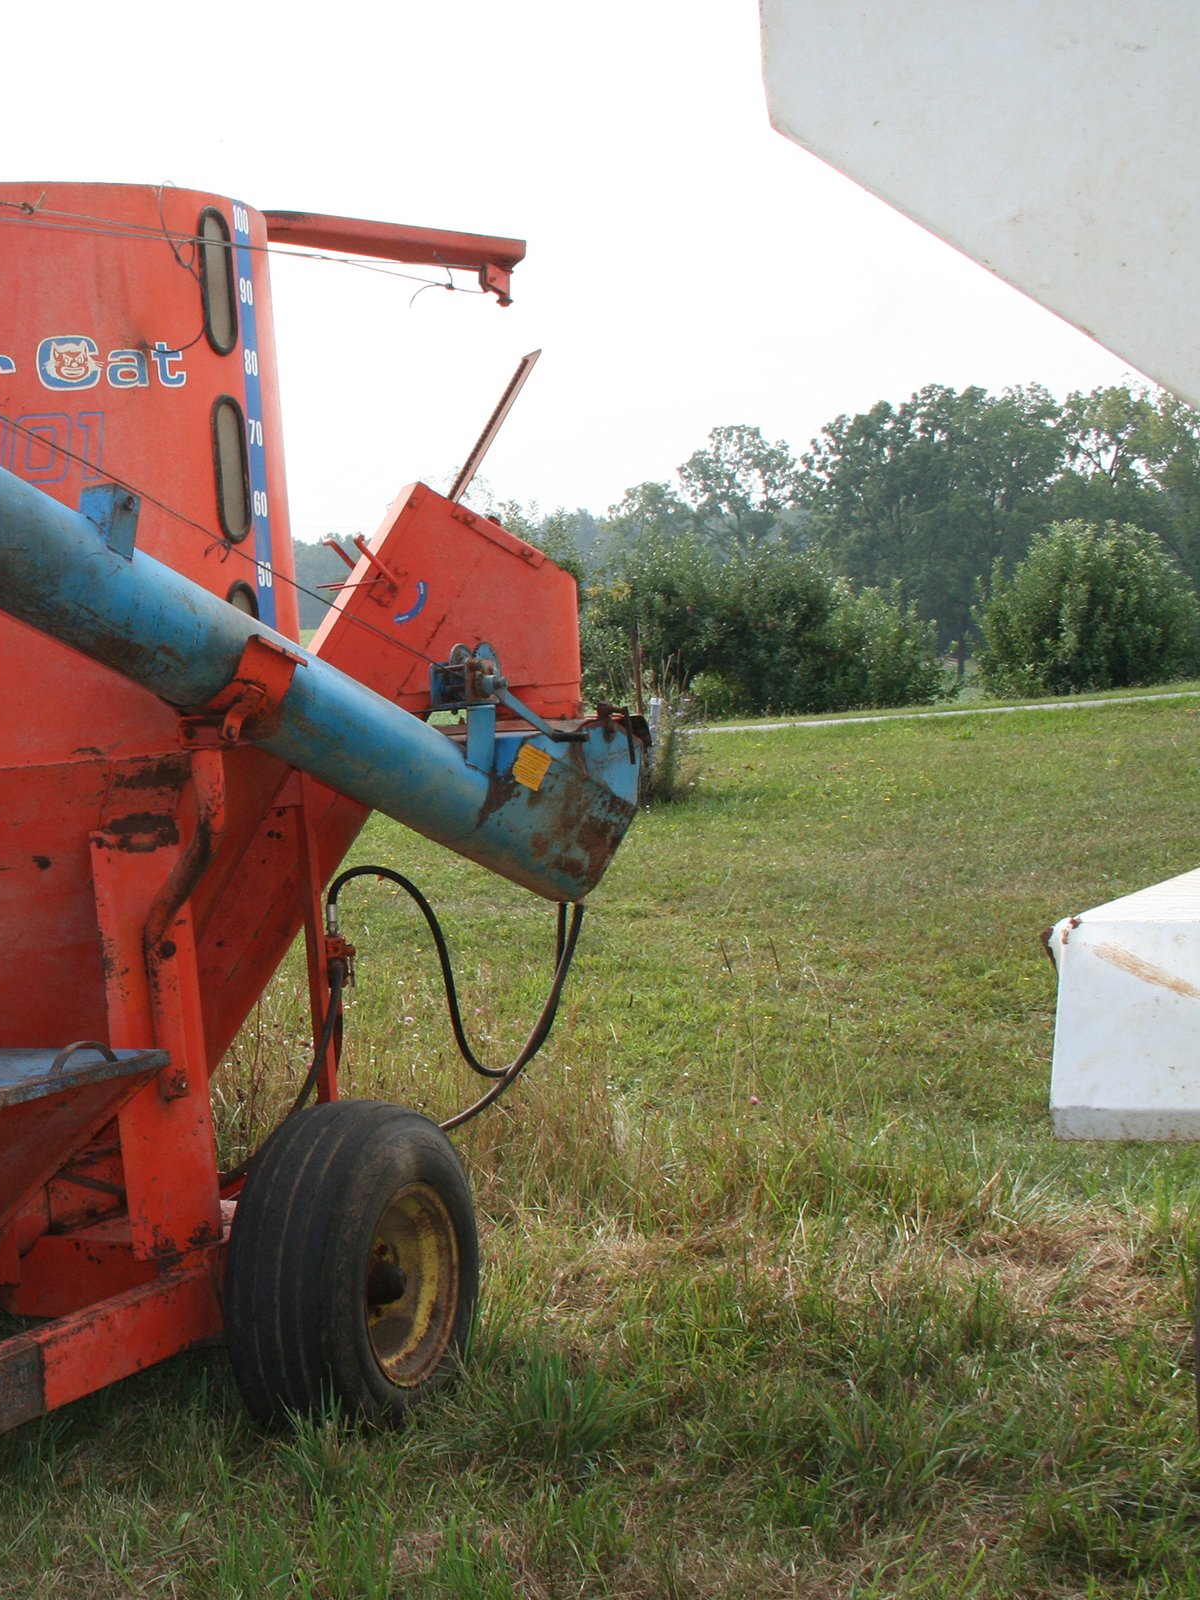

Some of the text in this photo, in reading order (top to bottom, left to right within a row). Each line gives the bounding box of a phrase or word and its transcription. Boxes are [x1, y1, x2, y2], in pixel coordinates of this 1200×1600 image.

[232, 204, 249, 235] 100
[239, 277, 253, 306] 90
[36, 334, 187, 392] Cat
[244, 348, 258, 377] 80
[248, 418, 263, 447] 70
[253, 489, 268, 518] 60
[257, 560, 273, 588] 50
